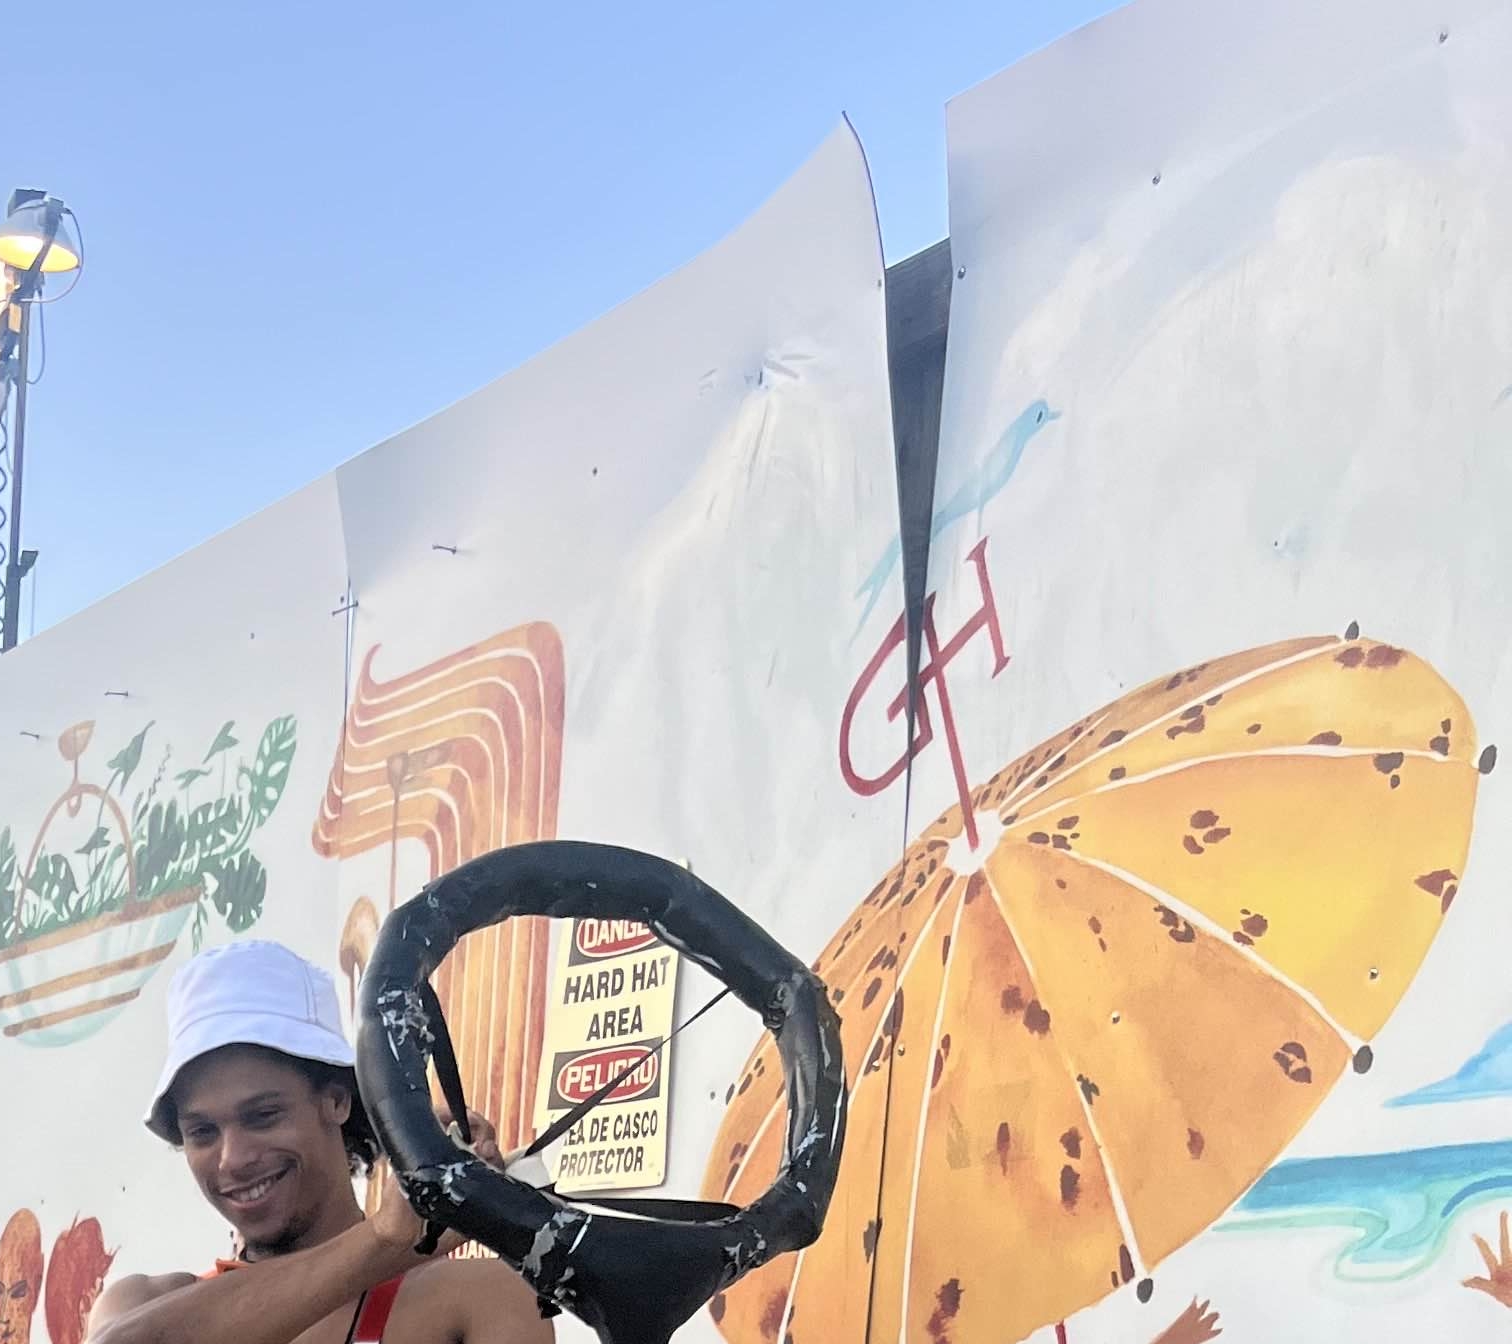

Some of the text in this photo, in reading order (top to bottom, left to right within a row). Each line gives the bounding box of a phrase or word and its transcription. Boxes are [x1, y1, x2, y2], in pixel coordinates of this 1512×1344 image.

[563, 955, 671, 1004] HARD HAT
[586, 1005, 643, 1041] AREA
[589, 1117, 610, 1142] DE
[613, 1110, 658, 1141] CASCO
[559, 1146, 645, 1178] PROTECTOR
